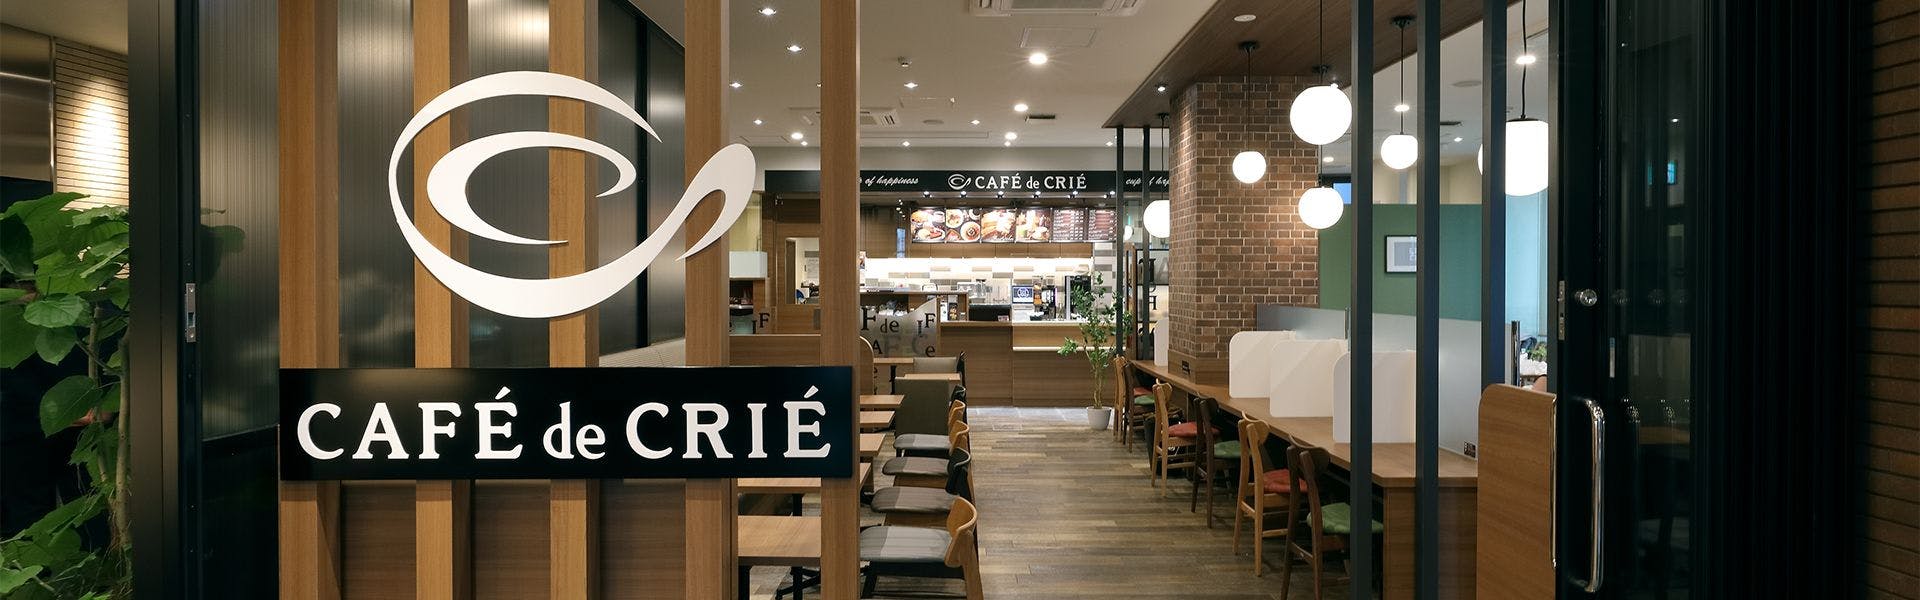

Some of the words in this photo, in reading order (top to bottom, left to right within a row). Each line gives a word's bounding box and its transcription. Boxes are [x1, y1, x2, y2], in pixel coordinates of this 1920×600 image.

[865, 176, 876, 186] of
[876, 175, 919, 186] happiness
[975, 172, 1022, 189] CAFÉ
[1026, 176, 1040, 189] de
[1044, 173, 1087, 189] CRIÉ
[297, 385, 524, 461] CAFÉ
[542, 401, 607, 460] de
[625, 384, 832, 460] CRIÉ
